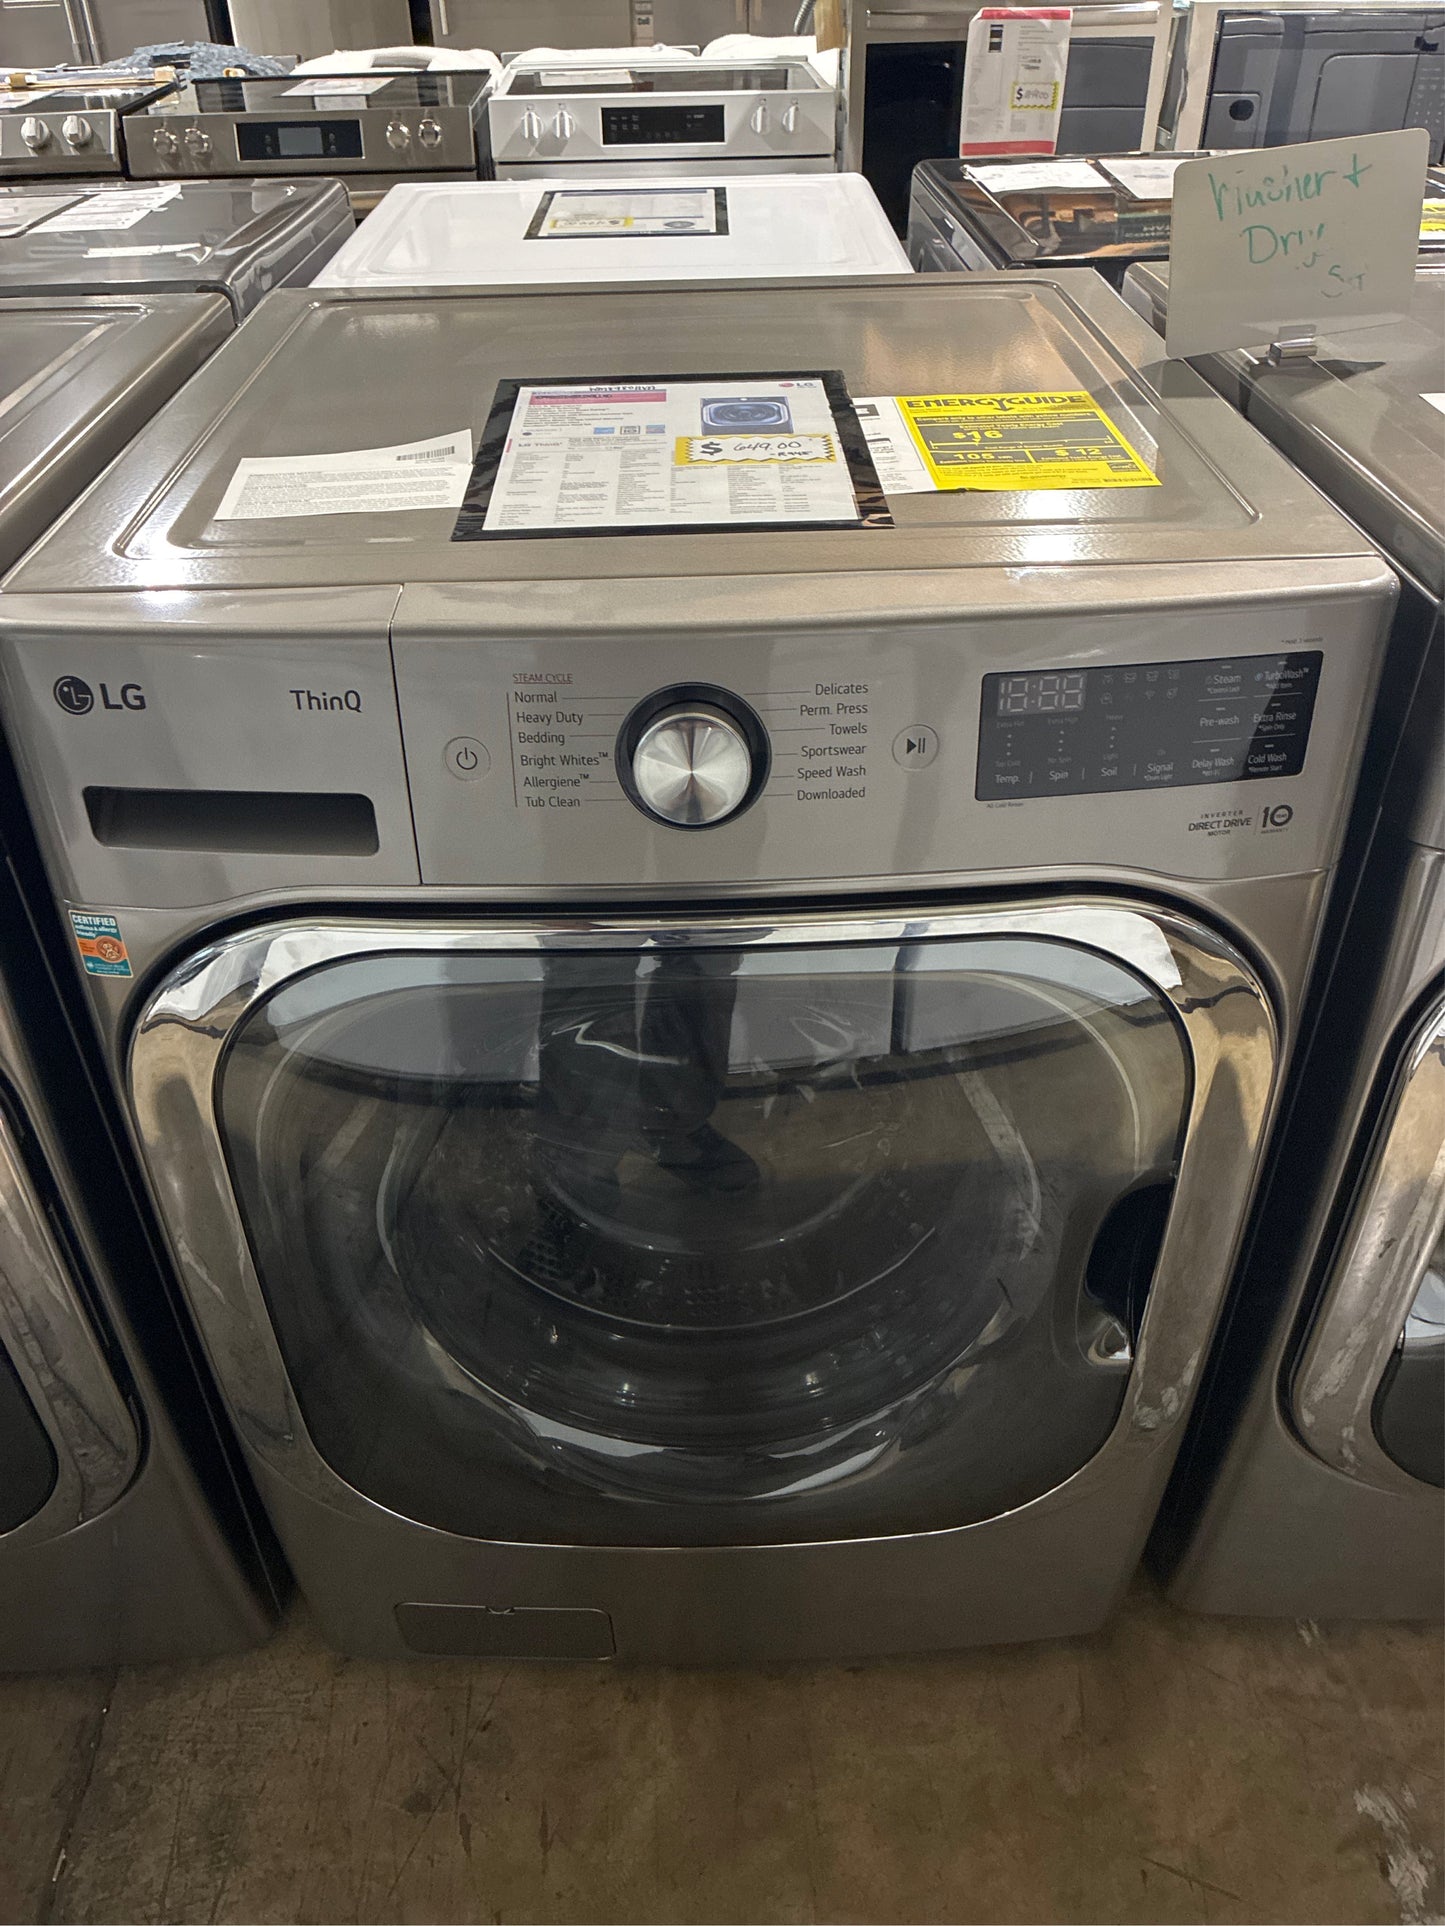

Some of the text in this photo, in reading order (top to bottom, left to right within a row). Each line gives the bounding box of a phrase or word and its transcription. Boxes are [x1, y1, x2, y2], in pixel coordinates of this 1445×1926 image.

[907, 396, 1087, 410] ENERGYGUIDE
[952, 430, 1003, 440] $16
[700, 441, 723, 455] $
[1075, 448, 1102, 456] 12
[953, 453, 994, 461] 105
[512, 673, 573, 683] STEAM CYCLE
[1213, 674, 1242, 685] Steam
[815, 683, 869, 696] Delicates
[99, 682, 147, 711] LG
[289, 689, 363, 713] ThinQ
[514, 691, 558, 703] Normal
[800, 703, 868, 716] Perm. Press
[516, 711, 584, 726] Heavy Duty
[1200, 715, 1240, 727] Pre-wash
[1253, 711, 1297, 723] Extra Rinse
[829, 723, 868, 735] Towels
[518, 732, 565, 746] Bedding
[800, 744, 867, 760] Sportswear
[1247, 752, 1288, 765] Cold Wash
[520, 754, 556, 769] Bright
[1192, 757, 1235, 770] Delay Wash
[797, 765, 867, 781] Speed Wash
[1100, 766, 1118, 777] Soil
[1147, 762, 1174, 775] Signal
[1049, 770, 1069, 782] Spin
[797, 787, 866, 801] Downloaded
[525, 796, 581, 808] Tub Clean
[1200, 809, 1244, 819] INVERTER
[1262, 804, 1294, 828] 10
[1188, 817, 1253, 832] DIRECT DRIVE
[72, 914, 117, 926] CERTIFIED
